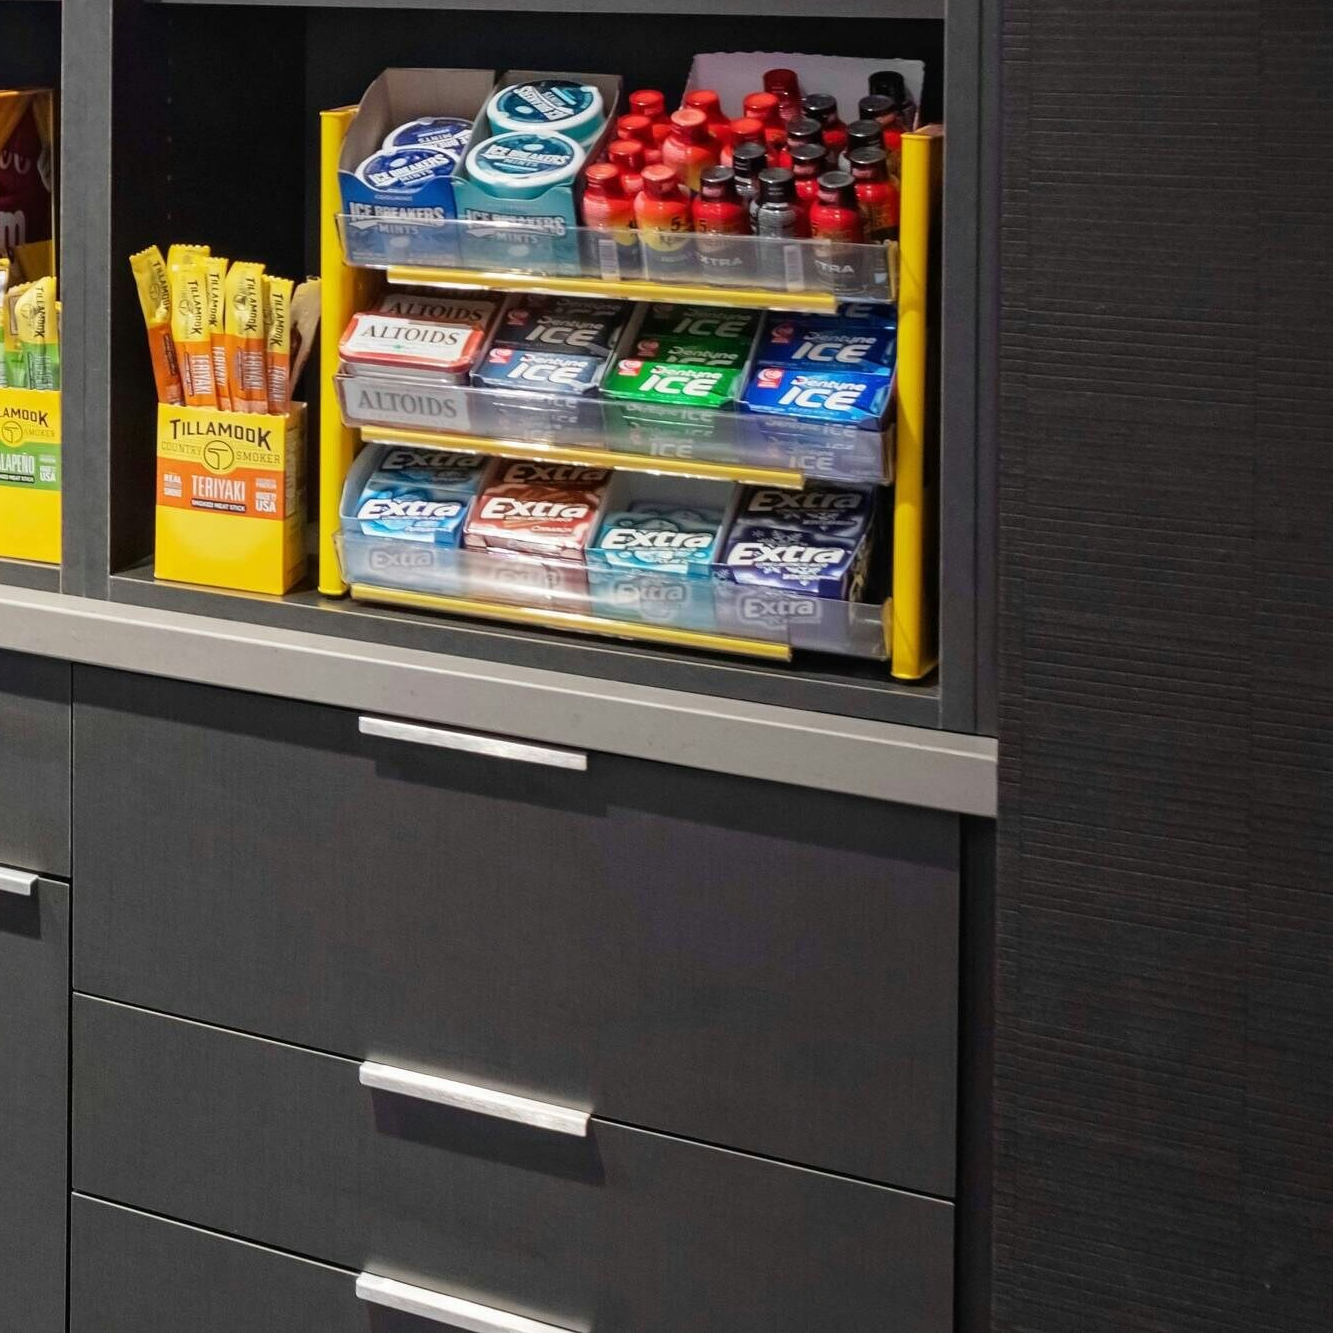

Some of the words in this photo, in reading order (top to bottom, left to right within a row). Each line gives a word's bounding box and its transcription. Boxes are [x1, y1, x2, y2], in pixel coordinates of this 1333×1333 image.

[388, 154, 450, 179] BREAKERS
[507, 150, 569, 166] BREAKERS
[186, 278, 203, 336] TILLAMOOK
[361, 324, 460, 346] ALTOIDS
[191, 353, 212, 396] TERIYAKI
[507, 365, 585, 384] ICE
[639, 374, 718, 397] ICE
[790, 375, 867, 393] Dentyne
[358, 390, 458, 418] ALTOIDS
[778, 387, 862, 411] ICE
[170, 418, 272, 452] TILLAMOOK
[236, 450, 281, 465] SMOKER
[191, 474, 246, 502] TERIYAKI
[255, 500, 277, 514] USA
[358, 497, 462, 521] Extra
[481, 496, 589, 521] Extra
[601, 528, 713, 549] Extra
[727, 542, 845, 566] Extra
[744, 597, 815, 617] Extra
